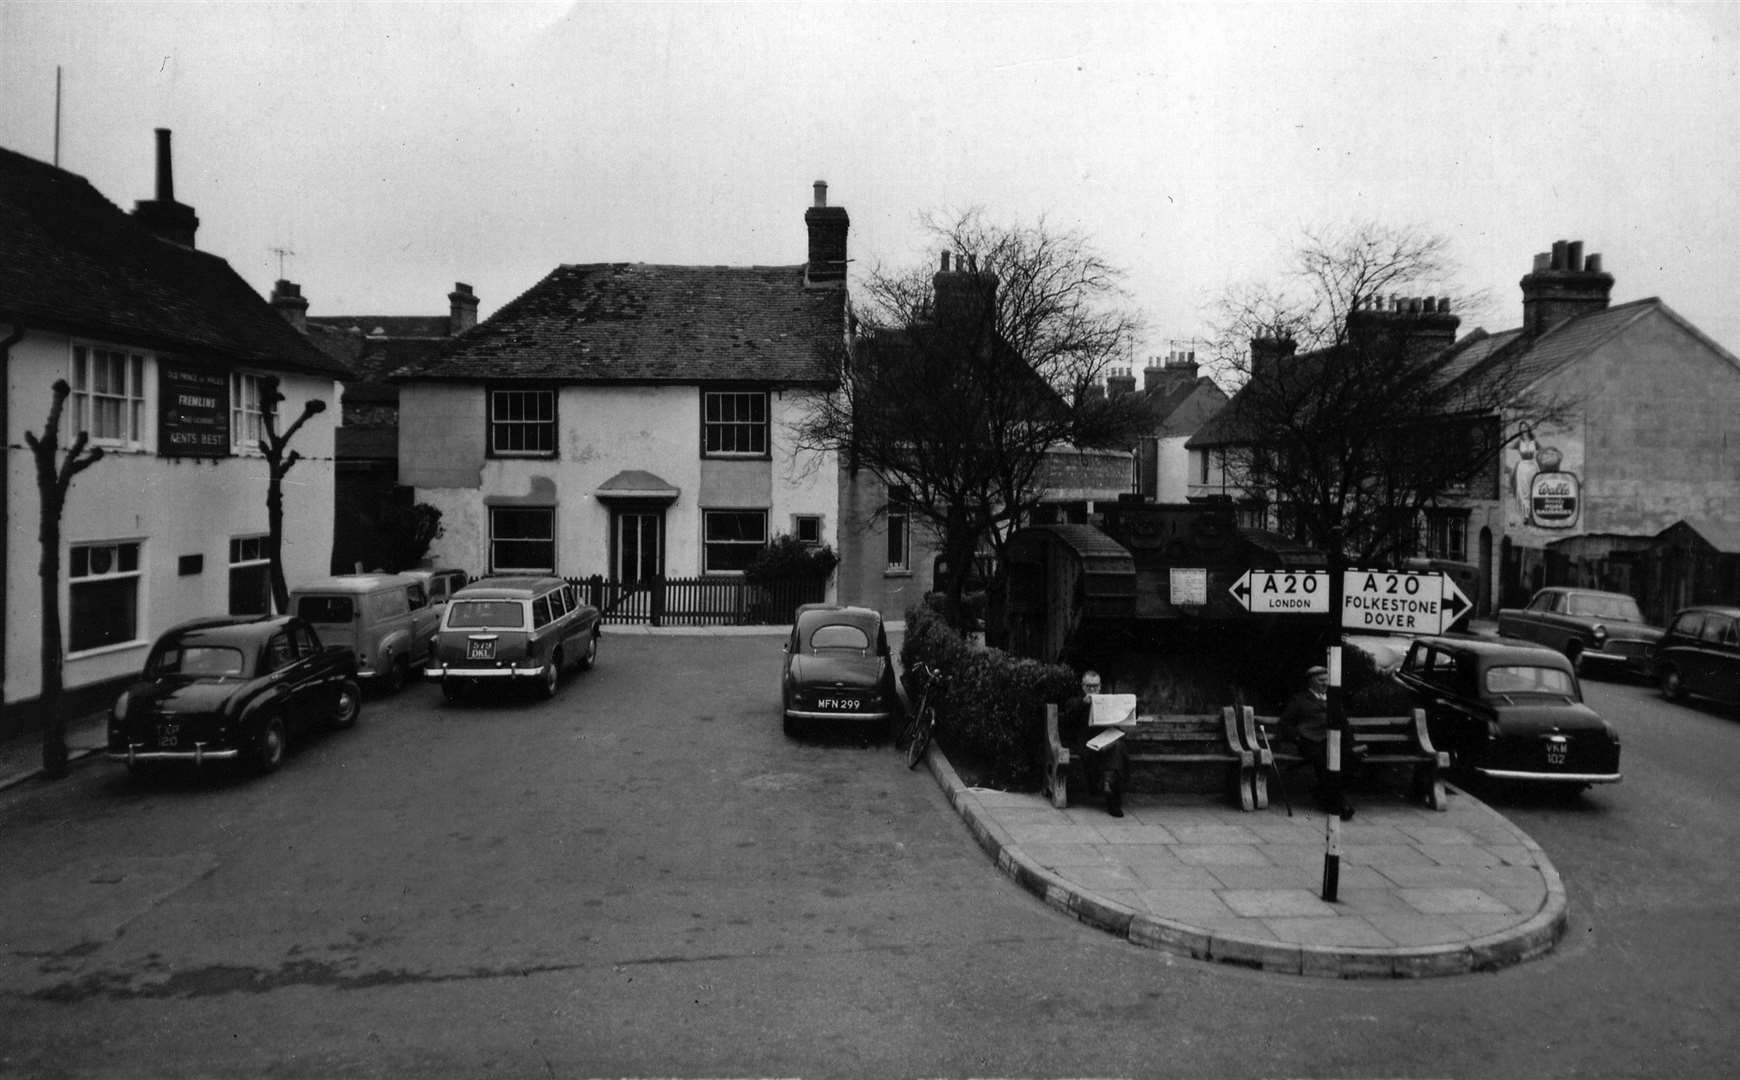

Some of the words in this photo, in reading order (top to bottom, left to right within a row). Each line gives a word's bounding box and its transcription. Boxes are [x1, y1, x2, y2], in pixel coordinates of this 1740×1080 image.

[178, 395, 216, 408] FREMLINS
[201, 433, 222, 445] BEST
[1263, 574, 1317, 594] A20
[1363, 573, 1419, 595] A20
[1269, 600, 1311, 608] LONDON
[1345, 595, 1438, 614] FOLKESTONE
[1364, 611, 1416, 628] DOVER
[818, 699, 839, 708] MFN
[840, 699, 860, 709] 299
[1547, 754, 1566, 764] 102
